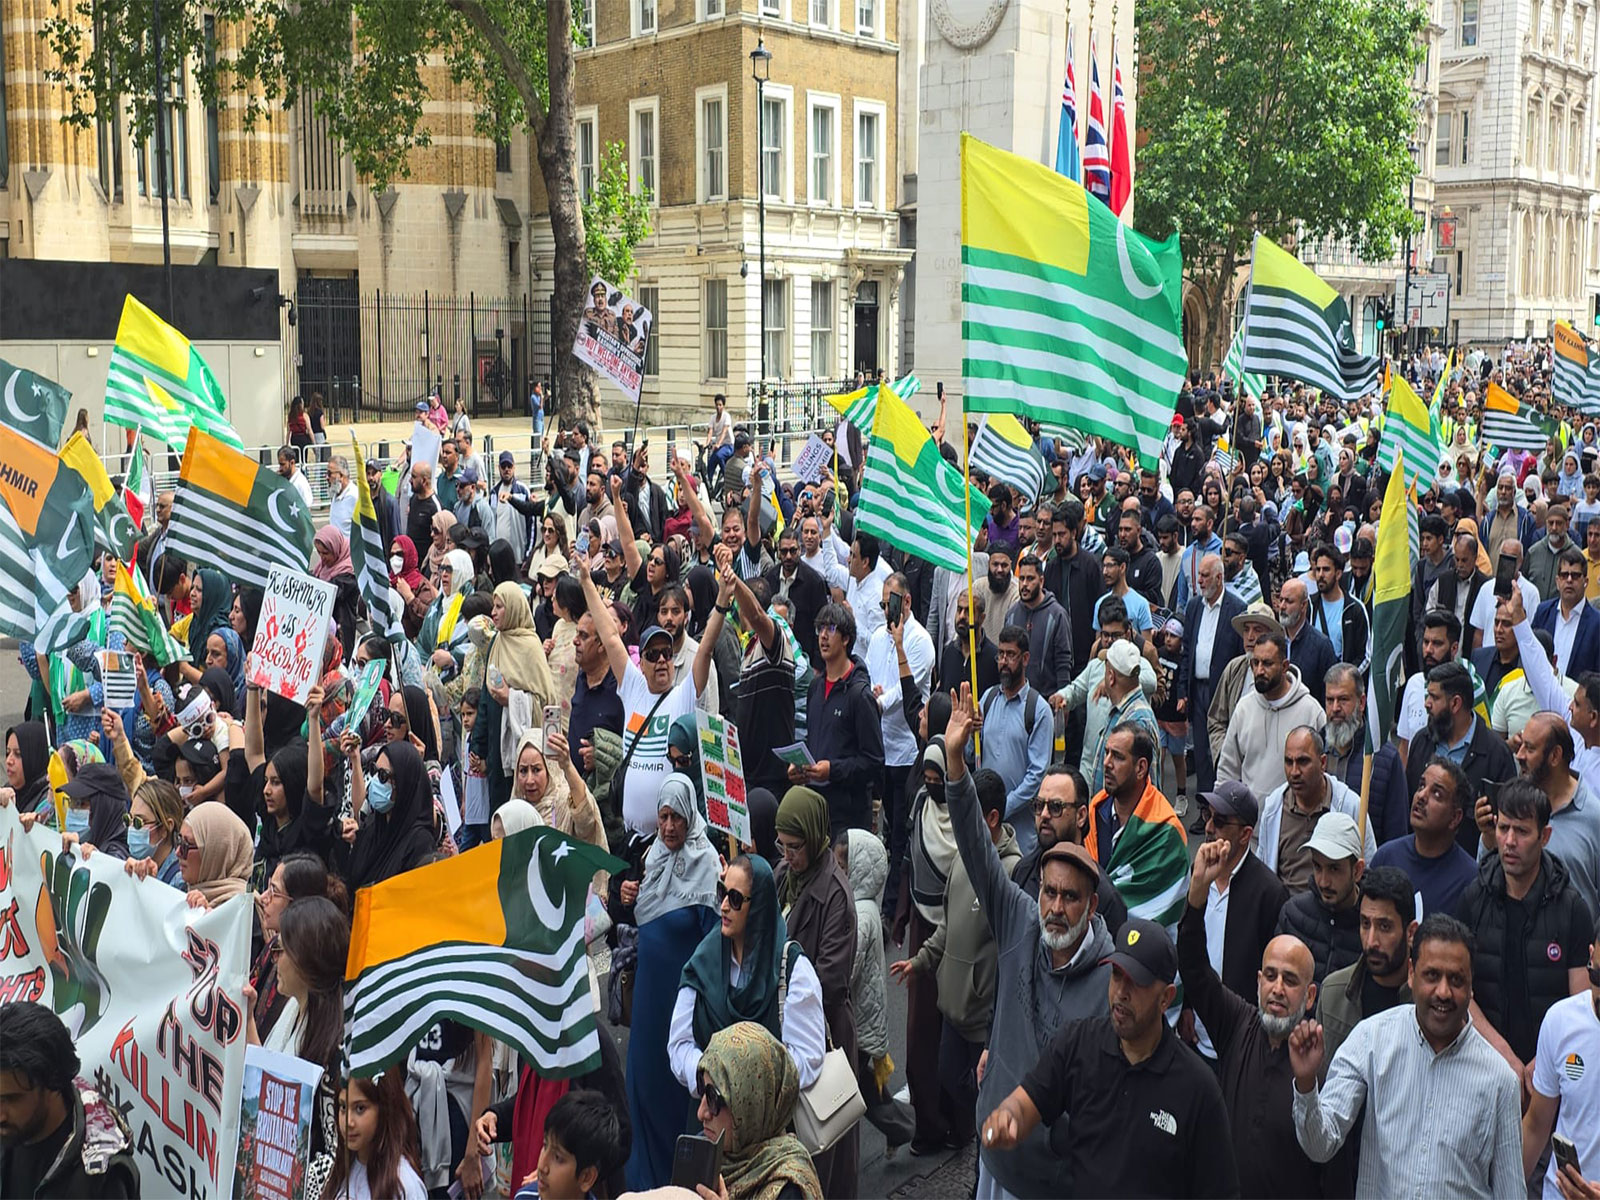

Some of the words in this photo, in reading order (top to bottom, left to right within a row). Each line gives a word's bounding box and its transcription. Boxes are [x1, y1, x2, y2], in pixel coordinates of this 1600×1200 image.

[798, 446, 812, 465] STOP
[799, 442, 823, 476] KILLINGS
[0, 461, 38, 499] HMIR
[267, 570, 328, 616] KASHMIR
[281, 613, 297, 638] IS
[253, 632, 313, 684] BLEEDING
[110, 1014, 220, 1196] KILLIN
[265, 1081, 284, 1114] STOP
[284, 1087, 296, 1119] THE
[256, 1110, 298, 1156] BRUTALITIES
